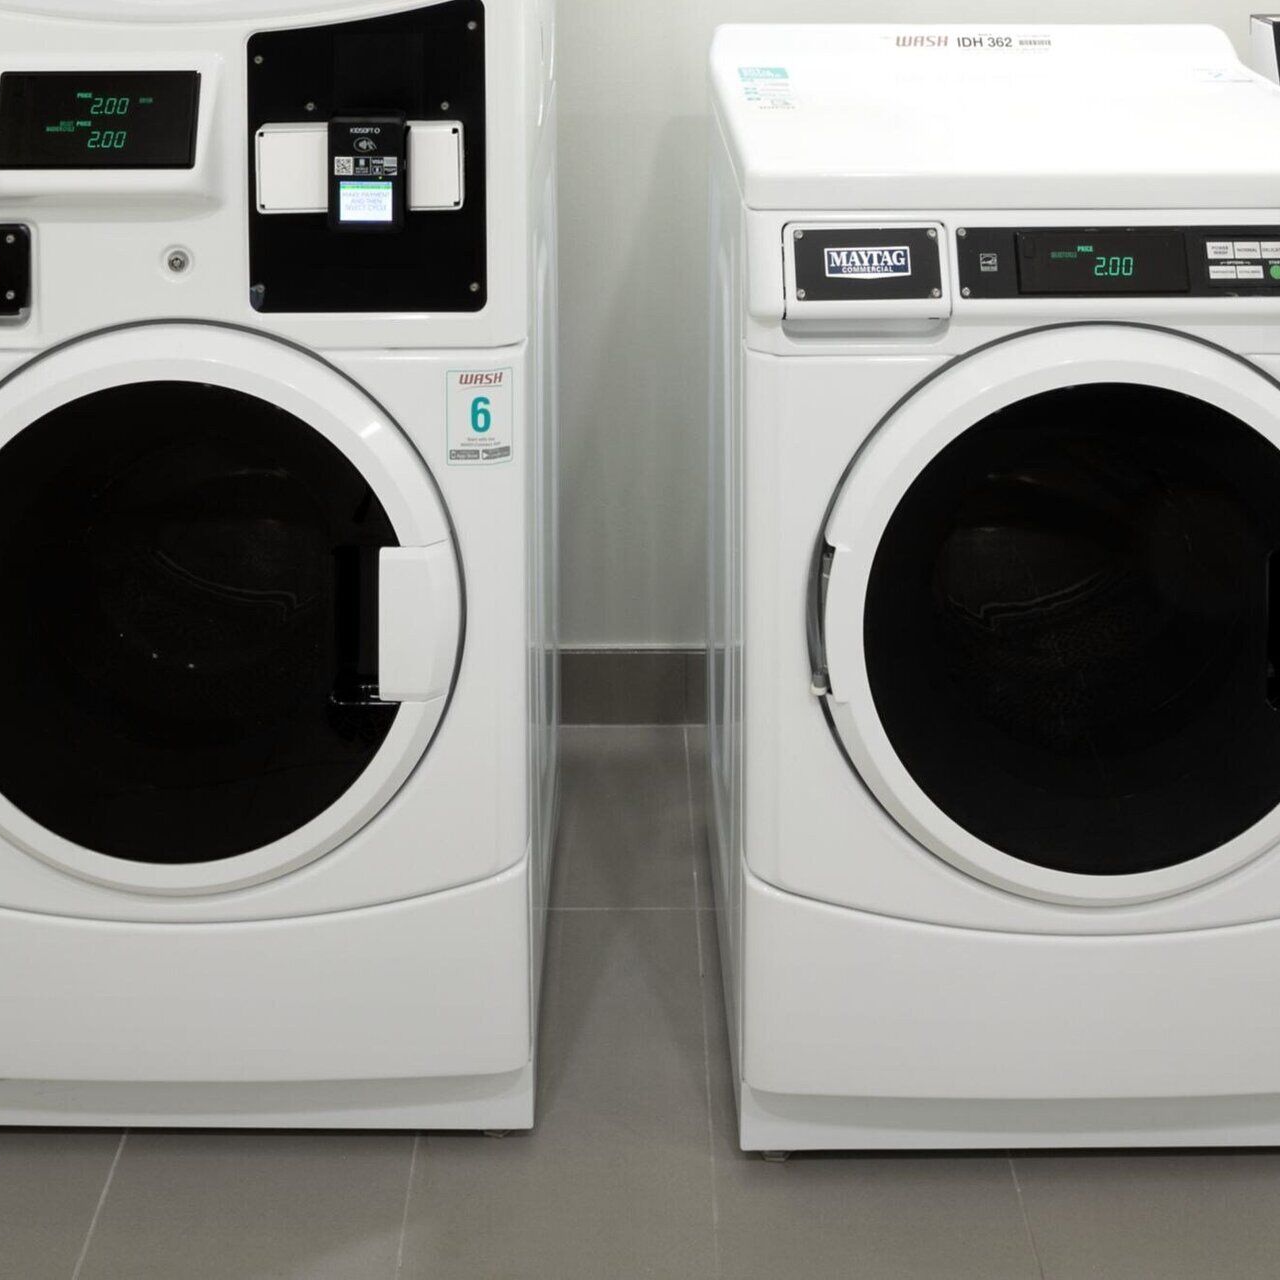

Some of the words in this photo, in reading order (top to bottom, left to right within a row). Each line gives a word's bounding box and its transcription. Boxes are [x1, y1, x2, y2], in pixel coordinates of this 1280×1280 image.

[895, 35, 949, 47] WASH
[957, 36, 983, 48] IDH
[987, 36, 1013, 48] 362
[90, 97, 130, 115] 2.00
[87, 131, 127, 148] 2.00
[828, 250, 906, 267] MAYTAG
[1094, 256, 1134, 276] 2.00
[458, 372, 504, 385] WASH
[471, 396, 491, 433] 6
